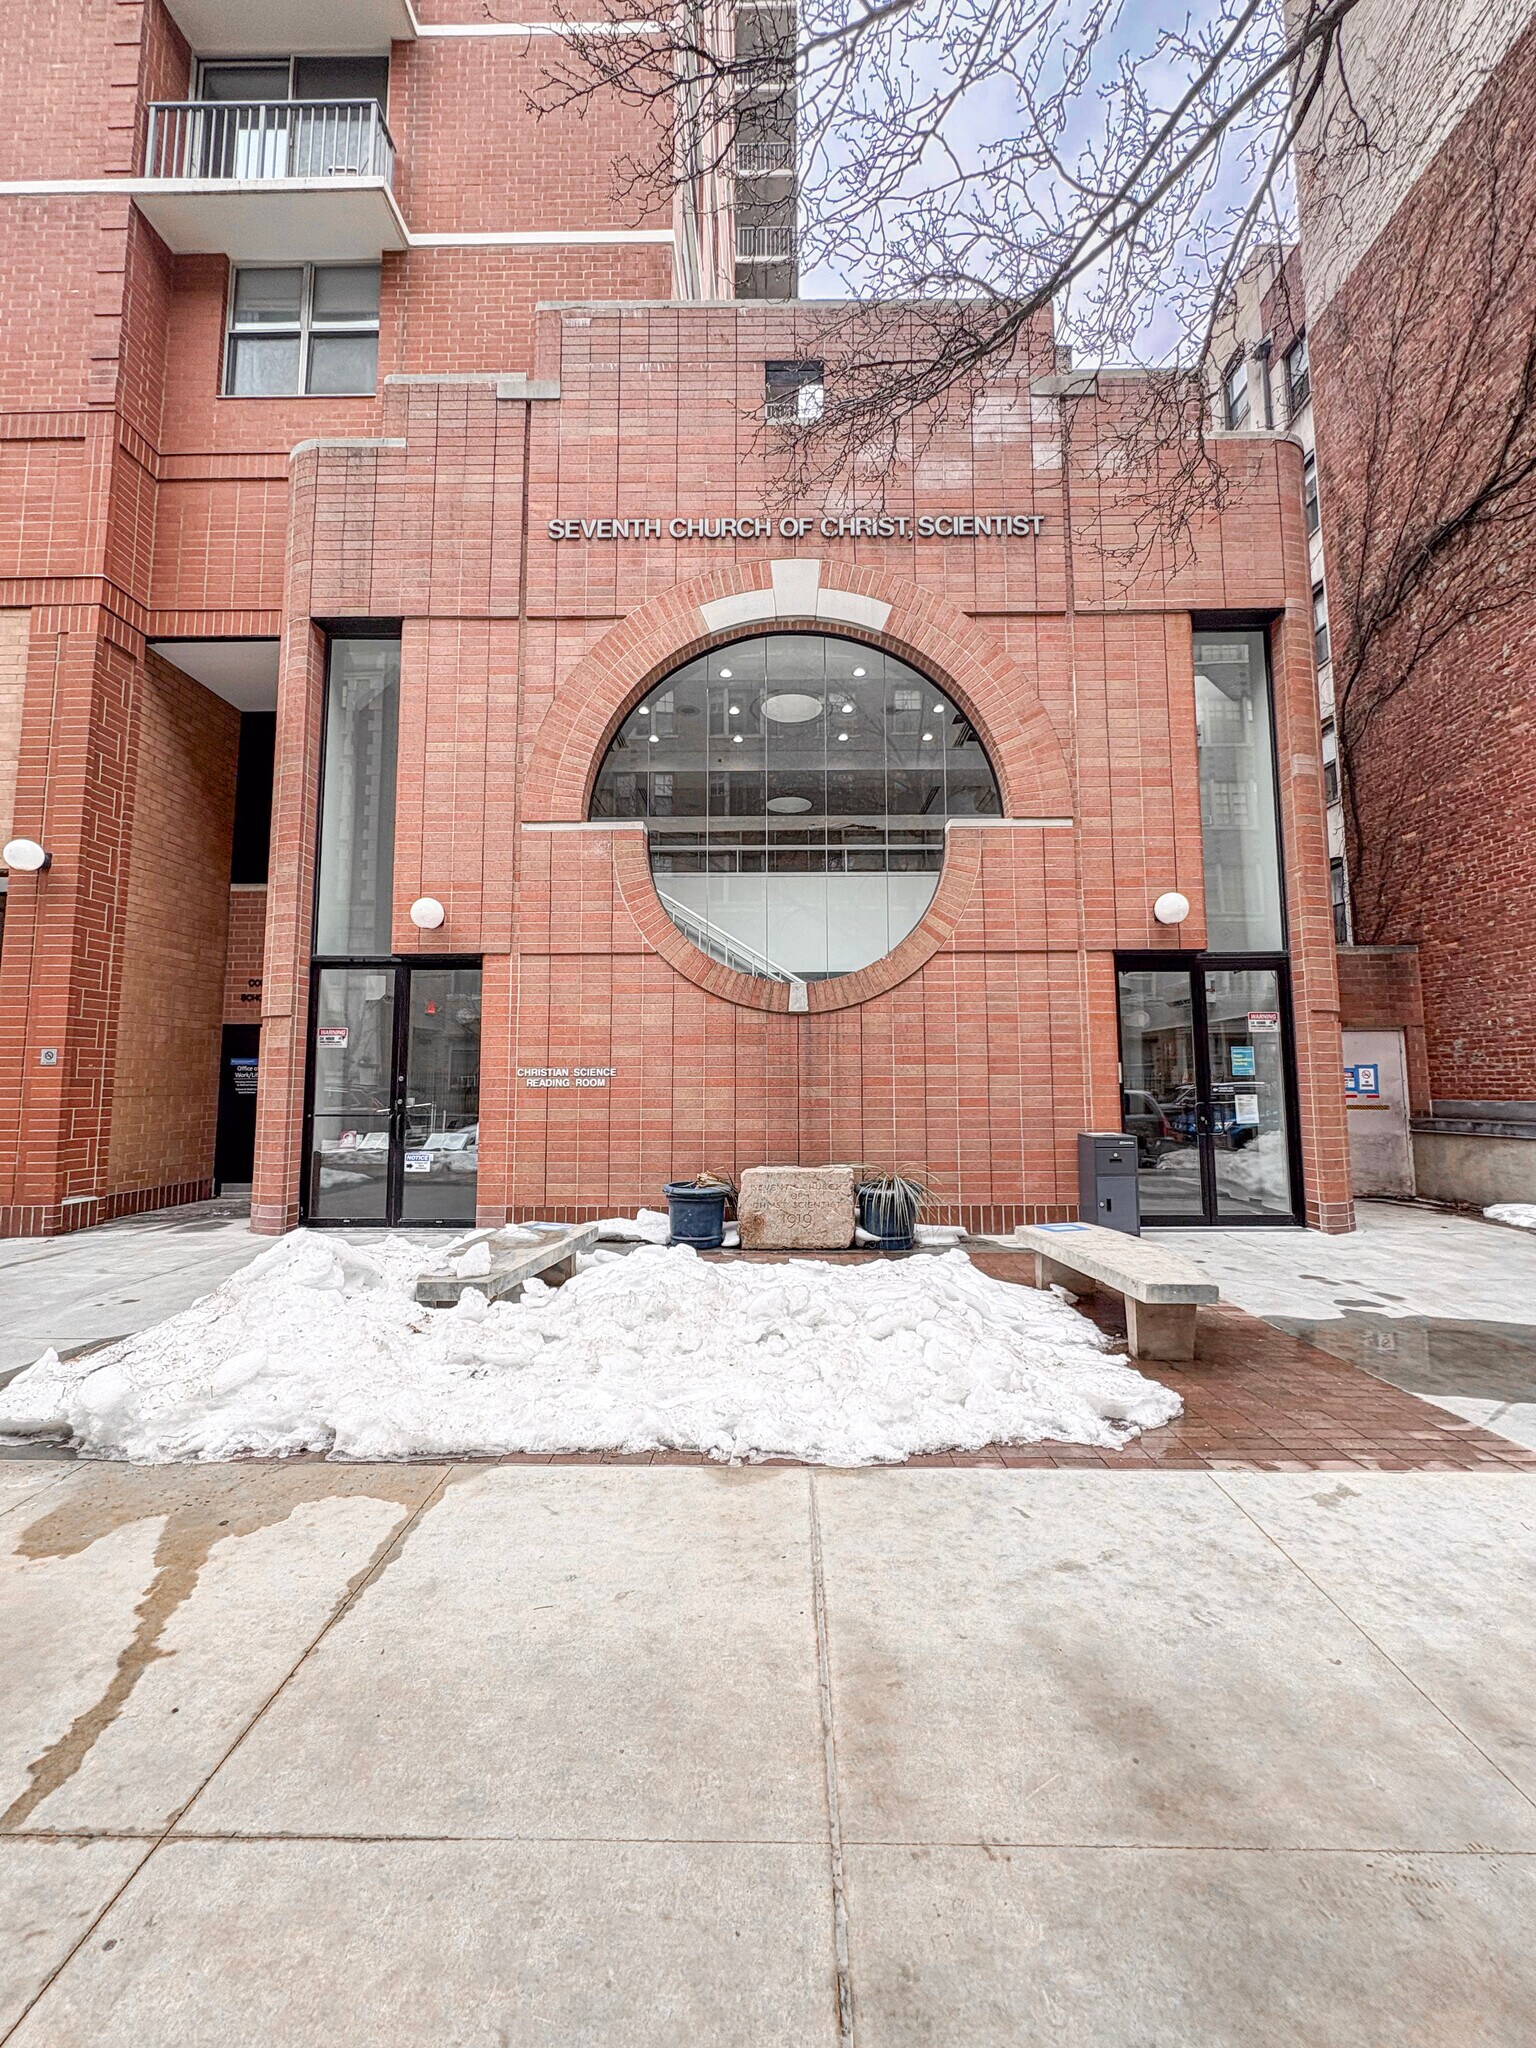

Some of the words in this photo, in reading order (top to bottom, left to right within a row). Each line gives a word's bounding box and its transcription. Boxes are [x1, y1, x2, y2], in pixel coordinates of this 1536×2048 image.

[548, 518, 662, 540] SEVENTH
[669, 517, 772, 539] CHURCH
[779, 517, 814, 538] OF
[820, 516, 915, 540] CHRIST,
[917, 515, 1045, 537] SCIENTIST
[517, 1068, 569, 1076] CHRISTIAN
[573, 1068, 617, 1076] SCIENCE
[526, 1078, 570, 1087] READING
[575, 1078, 606, 1087] ROOM
[783, 1211, 813, 1229] 1919
